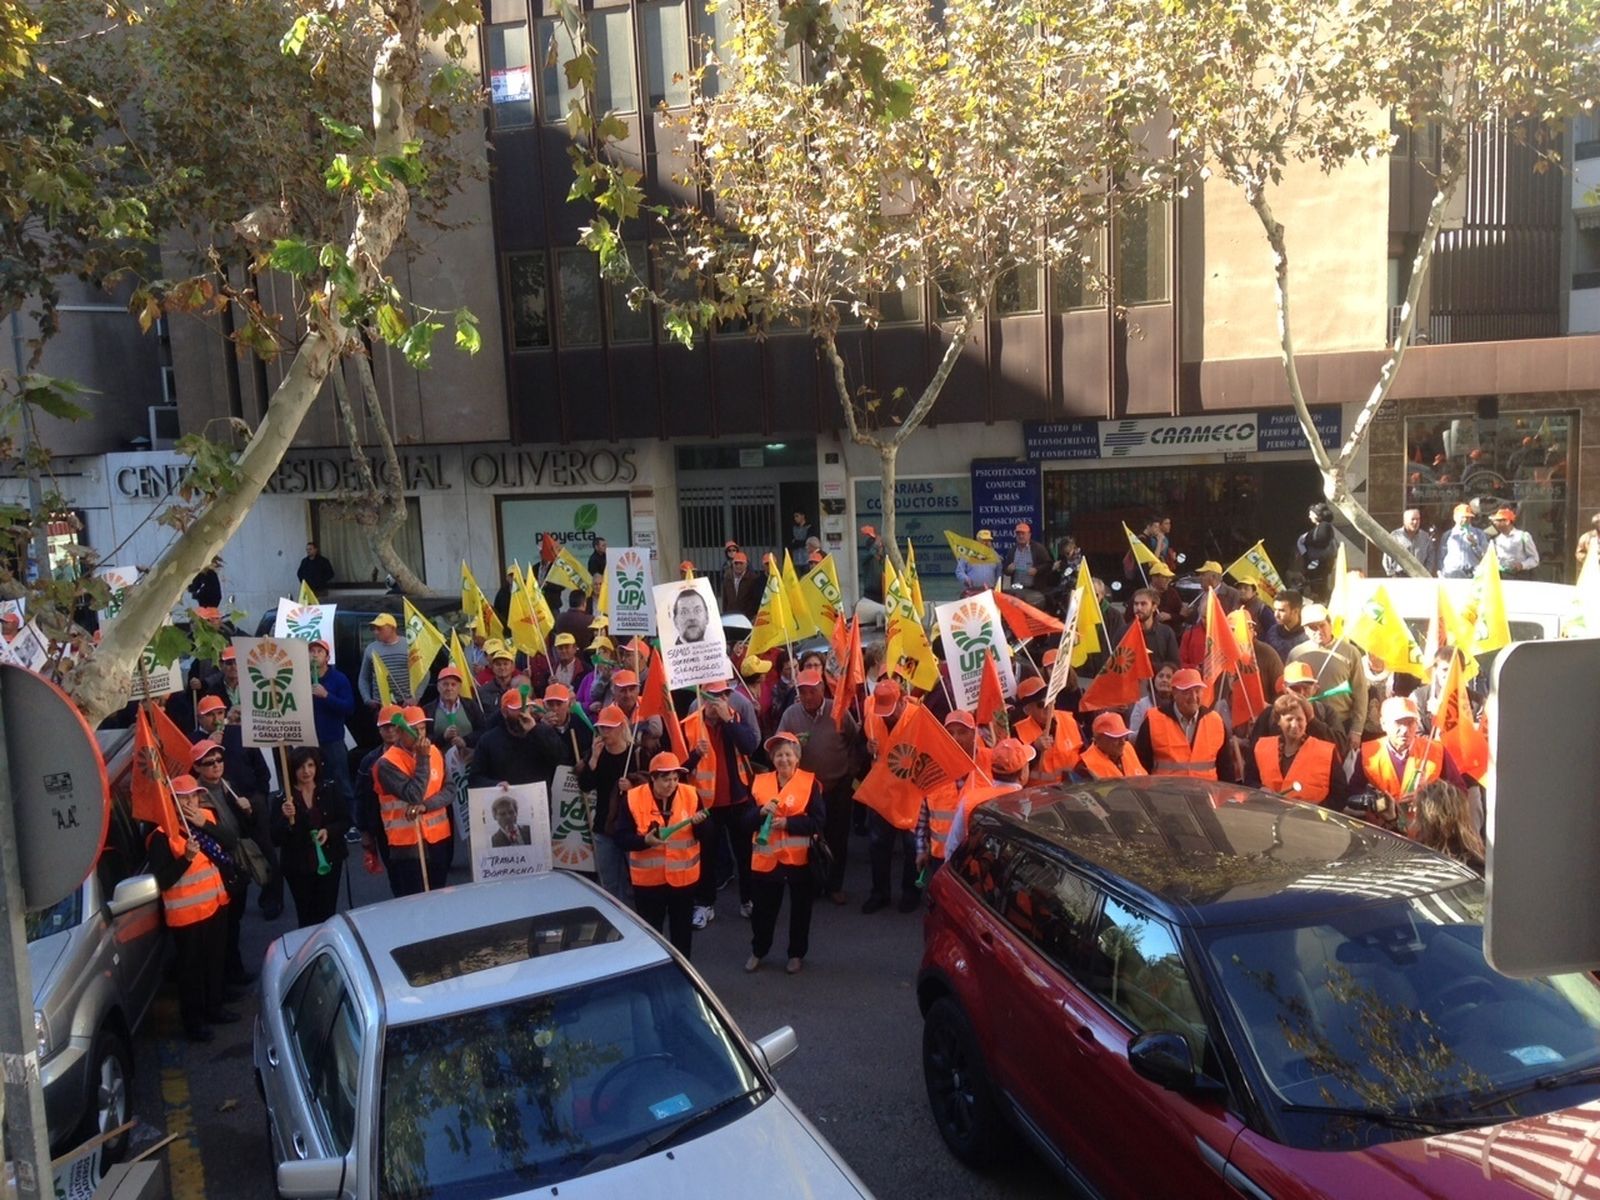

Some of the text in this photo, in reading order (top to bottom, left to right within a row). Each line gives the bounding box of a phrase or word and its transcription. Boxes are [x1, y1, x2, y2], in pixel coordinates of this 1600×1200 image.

[1038, 424, 1082, 433] CENTRO DE
[1151, 423, 1255, 444] CARMECO
[1028, 436, 1096, 446] RECONOCIMIENTO
[1030, 449, 1097, 458] DE CONDUCTORES
[469, 448, 638, 488] OLIVEROS
[985, 480, 1027, 489] CONDUCIR
[992, 493, 1020, 501] ARMAS
[866, 496, 959, 509] CODUCTORES
[979, 505, 1034, 514] EXTRANJEROS
[617, 590, 646, 610] UPA
[252, 691, 297, 716] UPA
